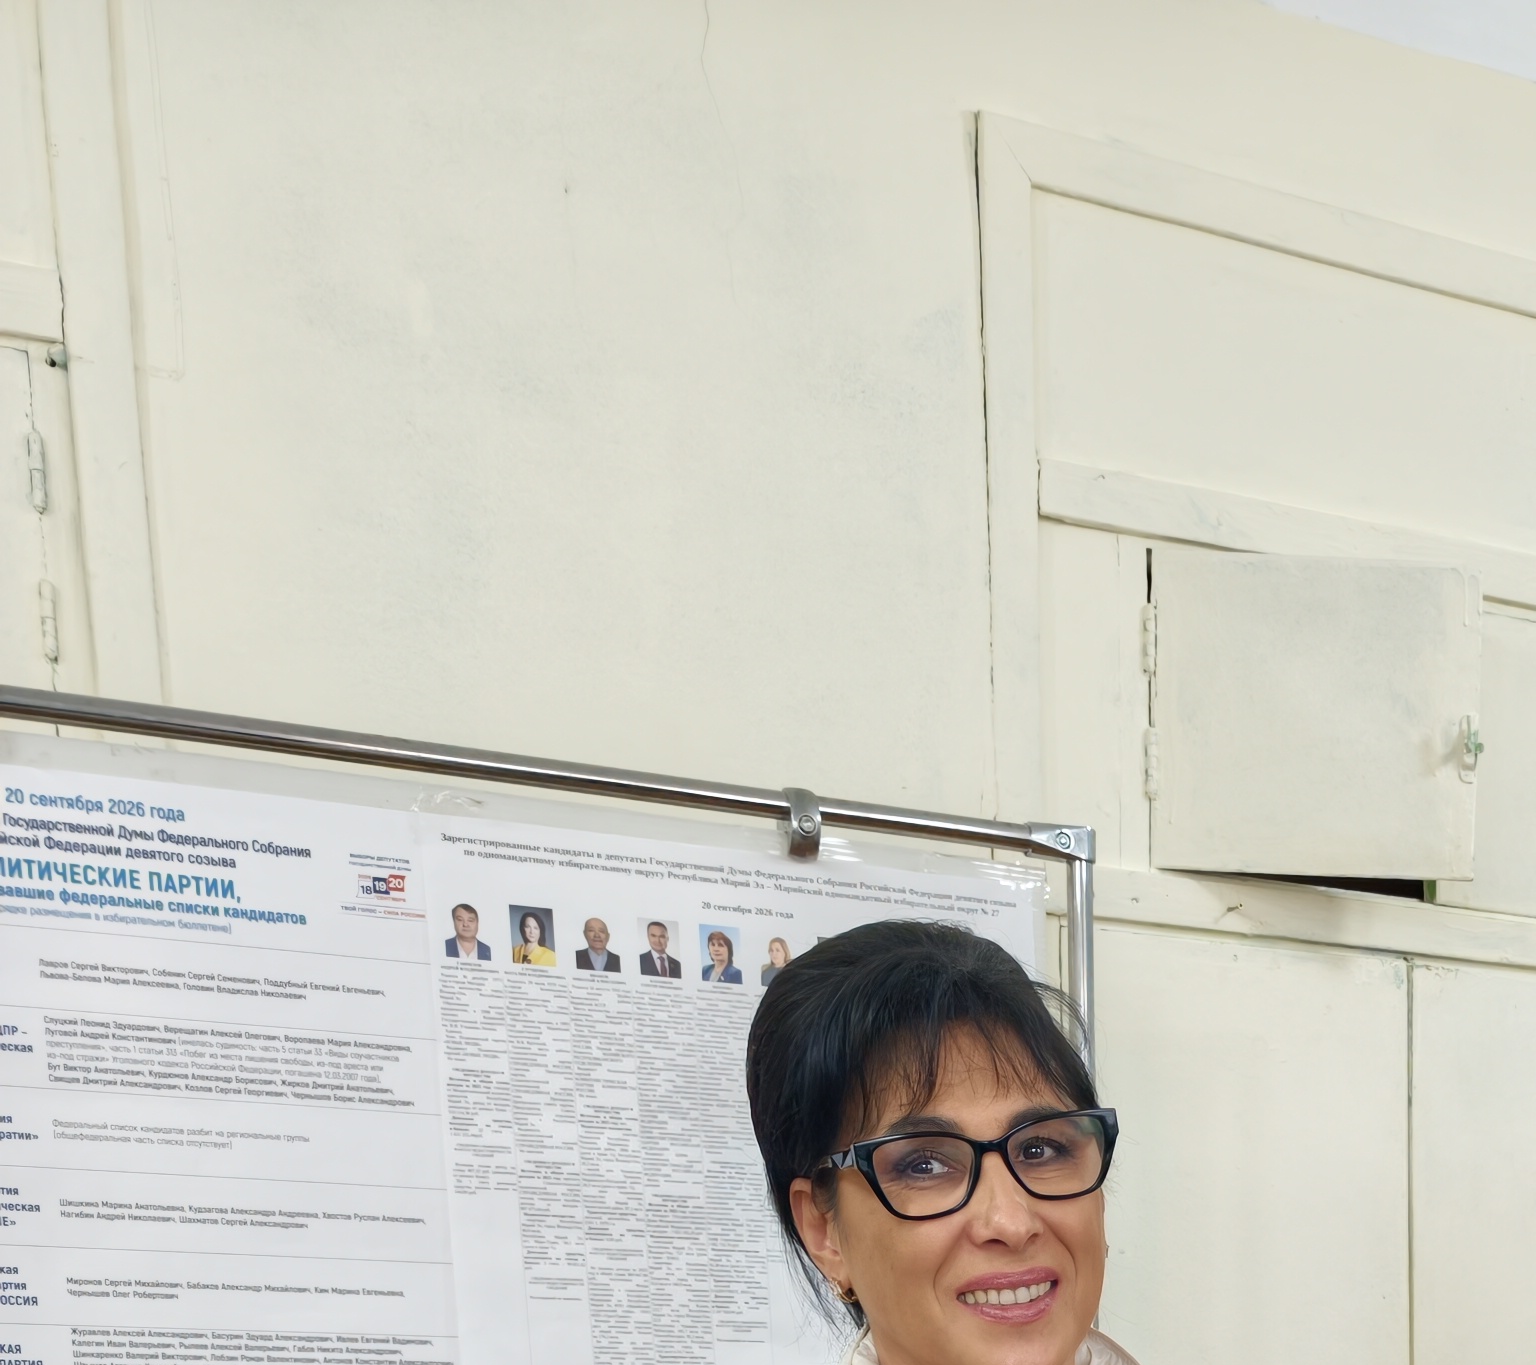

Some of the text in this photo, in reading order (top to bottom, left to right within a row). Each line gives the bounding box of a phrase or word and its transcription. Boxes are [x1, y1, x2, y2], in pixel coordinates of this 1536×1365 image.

[5, 787, 185, 822] 20 сентября 2026 года
[2, 813, 311, 857] Государственной Думы Федерального Собрания
[44, 836, 121, 855] Федерации
[125, 848, 184, 862] девятого
[188, 854, 236, 868] созыва
[440, 833, 541, 851] Зарегистрированные
[543, 847, 594, 857] кандидаты
[604, 854, 647, 863] депутаты
[477, 852, 556, 865] одномандатному
[558, 860, 632, 873] избирательному
[667, 871, 718, 883] Республика
[148, 872, 241, 902] ПАРТИИ,
[360, 878, 403, 894] 18 19 20
[58, 889, 164, 910] федеральные
[168, 902, 219, 916] списки
[223, 907, 307, 924] кандидатов
[701, 901, 794, 919] 20 сентября 2026 года
[70, 961, 99, 974] Сергей
[100, 964, 150, 978] Викторович,
[187, 971, 215, 981] Сергей
[216, 974, 262, 985] Семенович,
[264, 978, 308, 988] Поддубный
[309, 982, 340, 991] Евгений
[103, 976, 130, 985] Мария
[216, 985, 259, 996] Владислав
[260, 989, 306, 999] Николаевич
[0, 1025, 18, 1036] ПР
[0, 1203, 41, 1213] ческая
[101, 1201, 132, 1209] Марина
[60, 1210, 94, 1218] Нагибин
[96, 1212, 125, 1221] Андрей
[220, 1217, 248, 1226] Сергей
[0, 1282, 27, 1292] ртия
[66, 1277, 102, 1285] Миронов
[104, 1278, 132, 1290] Сергей
[134, 1280, 185, 1291] Михайлович,
[221, 1283, 262, 1292] Александр
